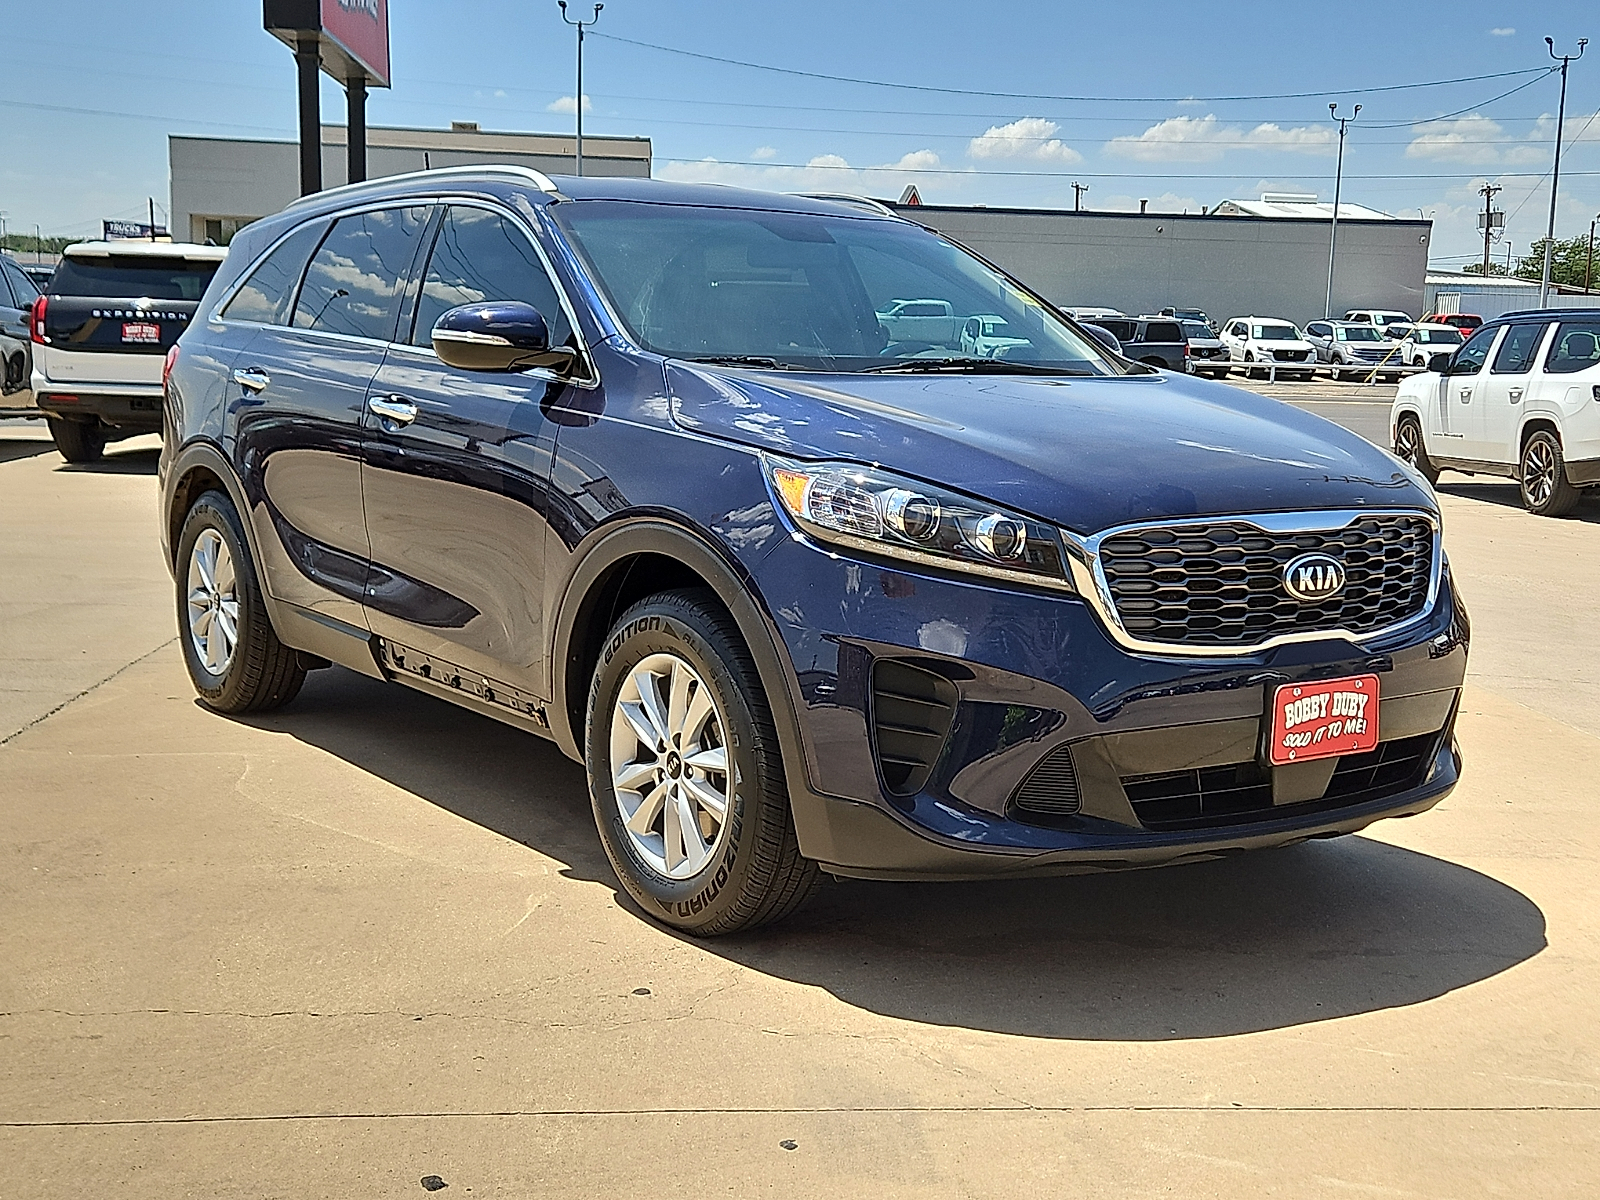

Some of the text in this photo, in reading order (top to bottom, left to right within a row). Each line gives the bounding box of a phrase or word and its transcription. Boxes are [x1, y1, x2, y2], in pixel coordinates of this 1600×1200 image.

[1297, 565, 1339, 592] KIA
[1284, 691, 1369, 730] BOBBY DUBY
[1282, 718, 1367, 748] SOLD IT TO ME!
